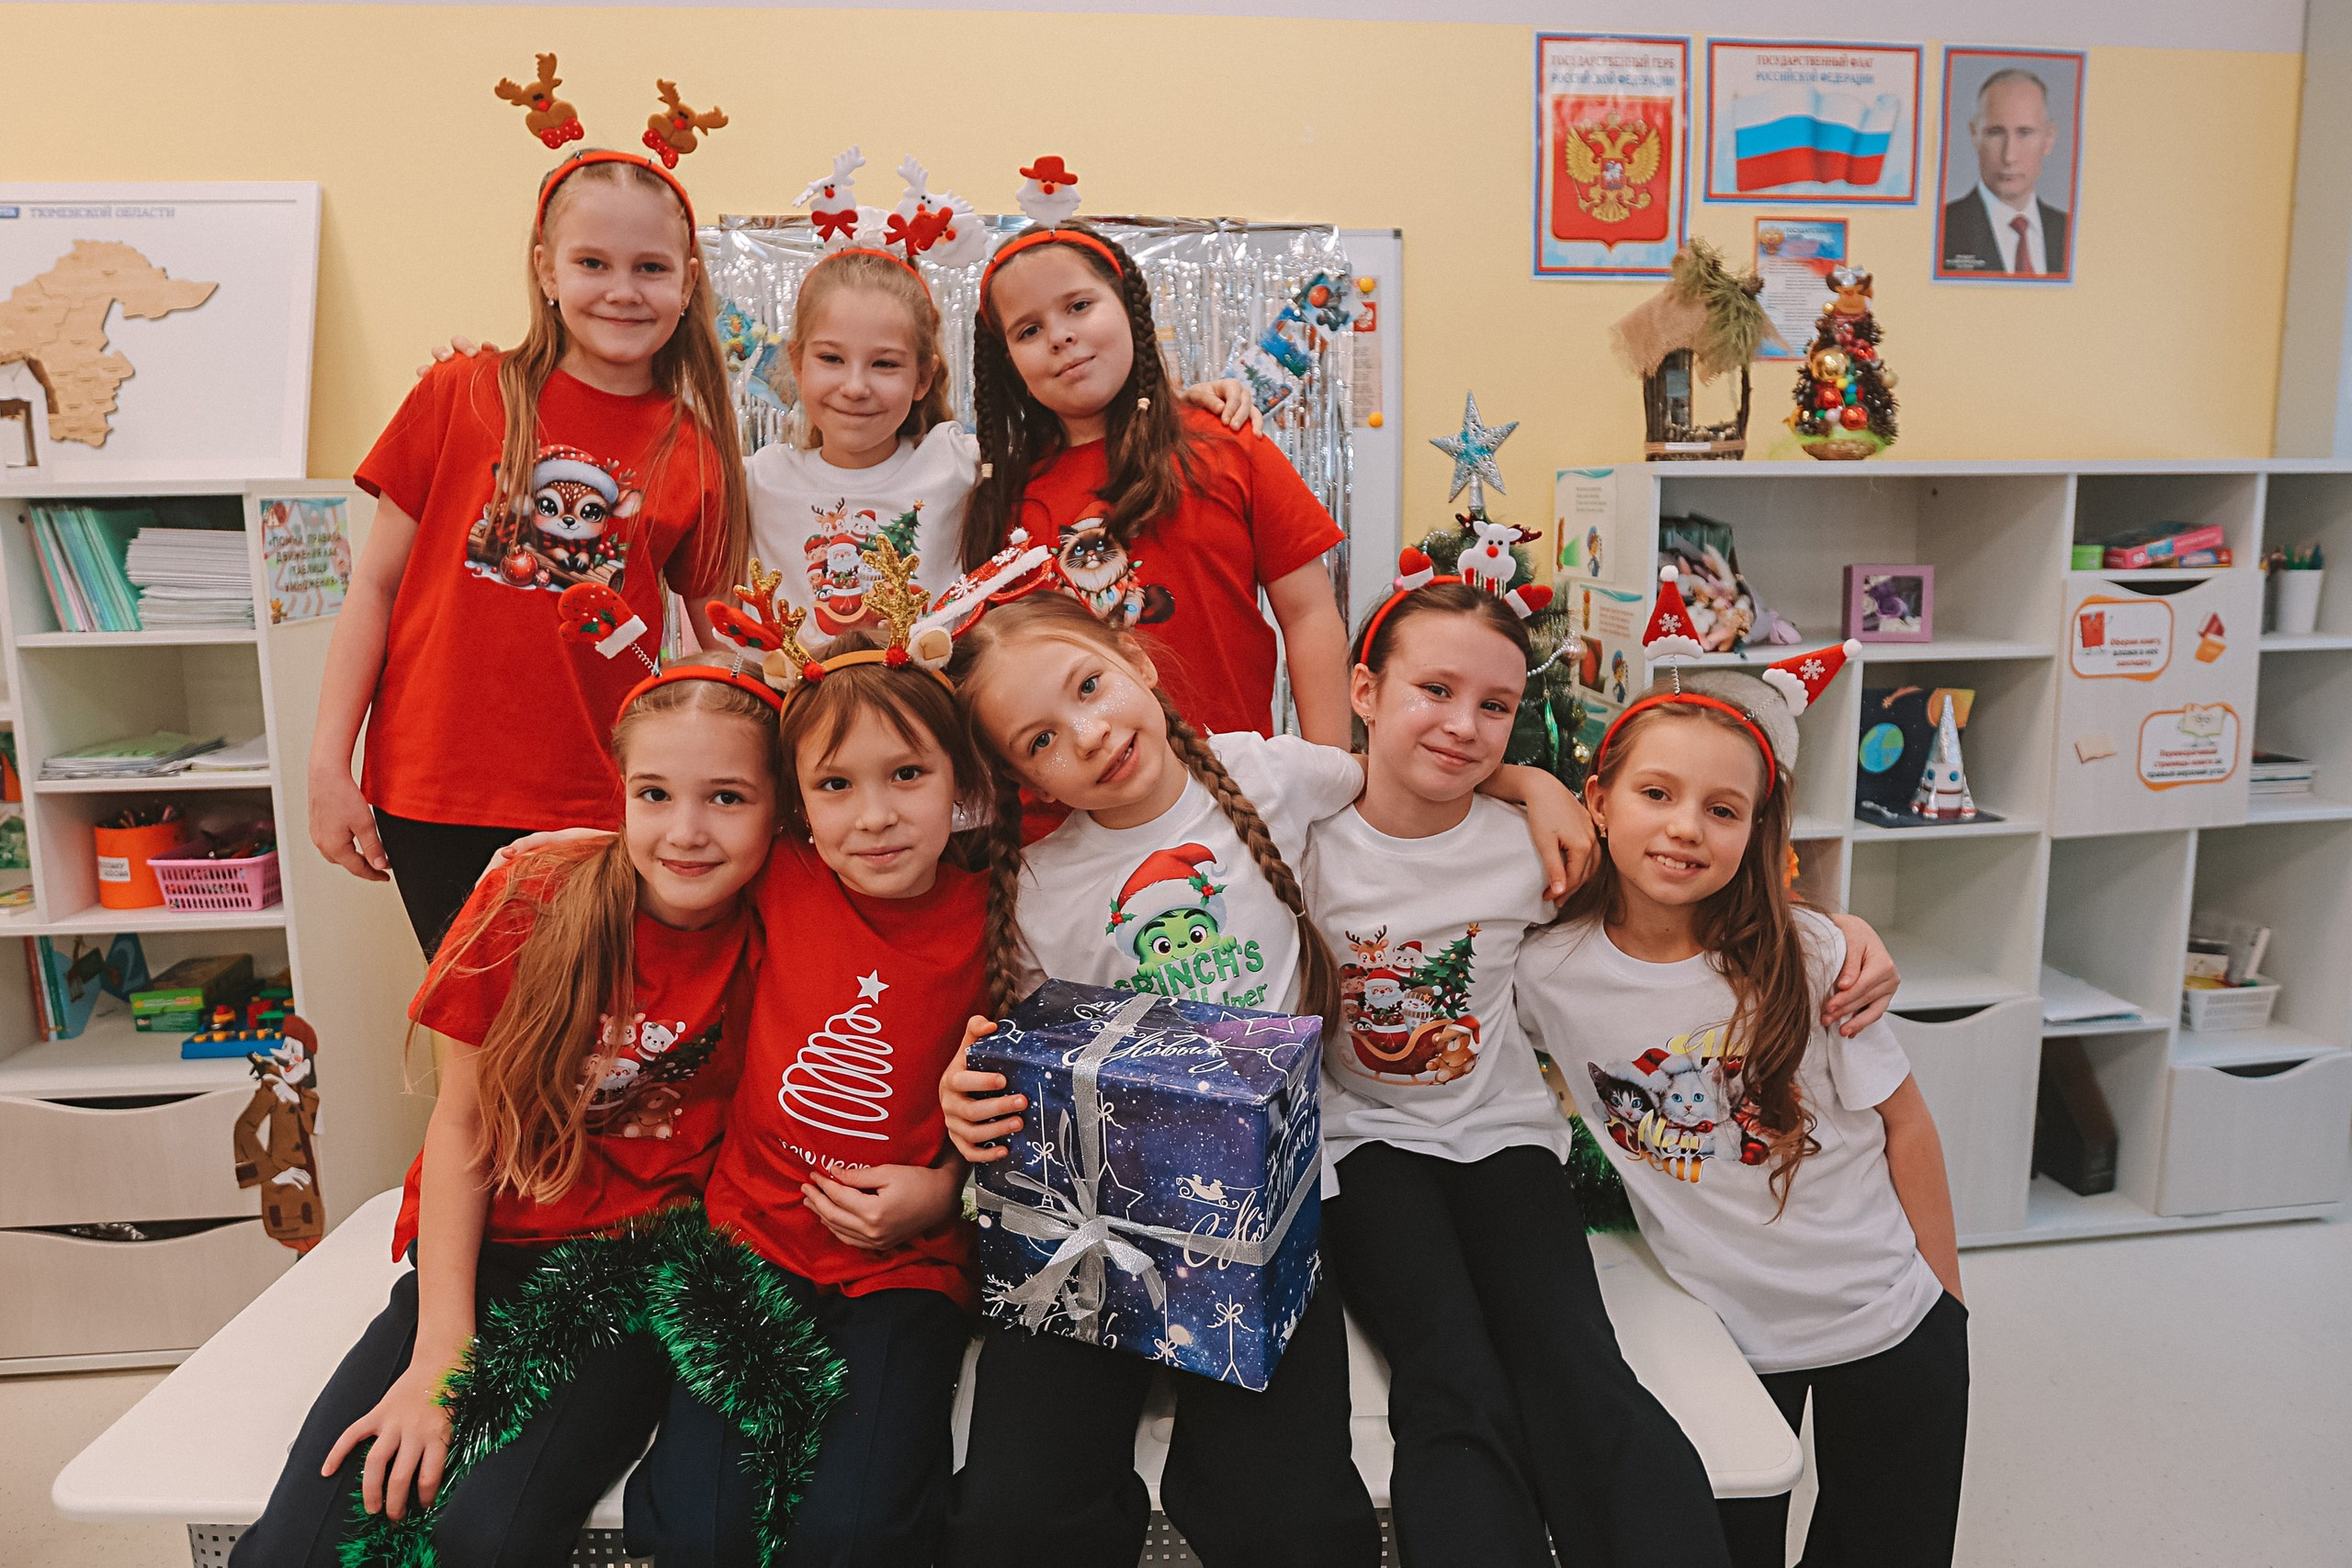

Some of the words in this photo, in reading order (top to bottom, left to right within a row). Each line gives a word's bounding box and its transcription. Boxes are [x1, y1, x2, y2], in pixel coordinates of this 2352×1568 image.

[1550, 54, 1650, 68] ГОСУДАРСТВЕННЫЙ
[1652, 57, 1677, 69] ГЕРБ
[1757, 53, 1849, 67] ГОСУДАРСТВЕННЫЙ
[1850, 57, 1874, 68] ФЛАГ
[1756, 69, 1818, 83] РОССИЙСКОЙ
[1820, 73, 1875, 85] ФЕДЕРАЦИИ
[30, 205, 112, 218] ТЮМЕНСКОЙ
[116, 206, 175, 218] ОБЛАСТИ
